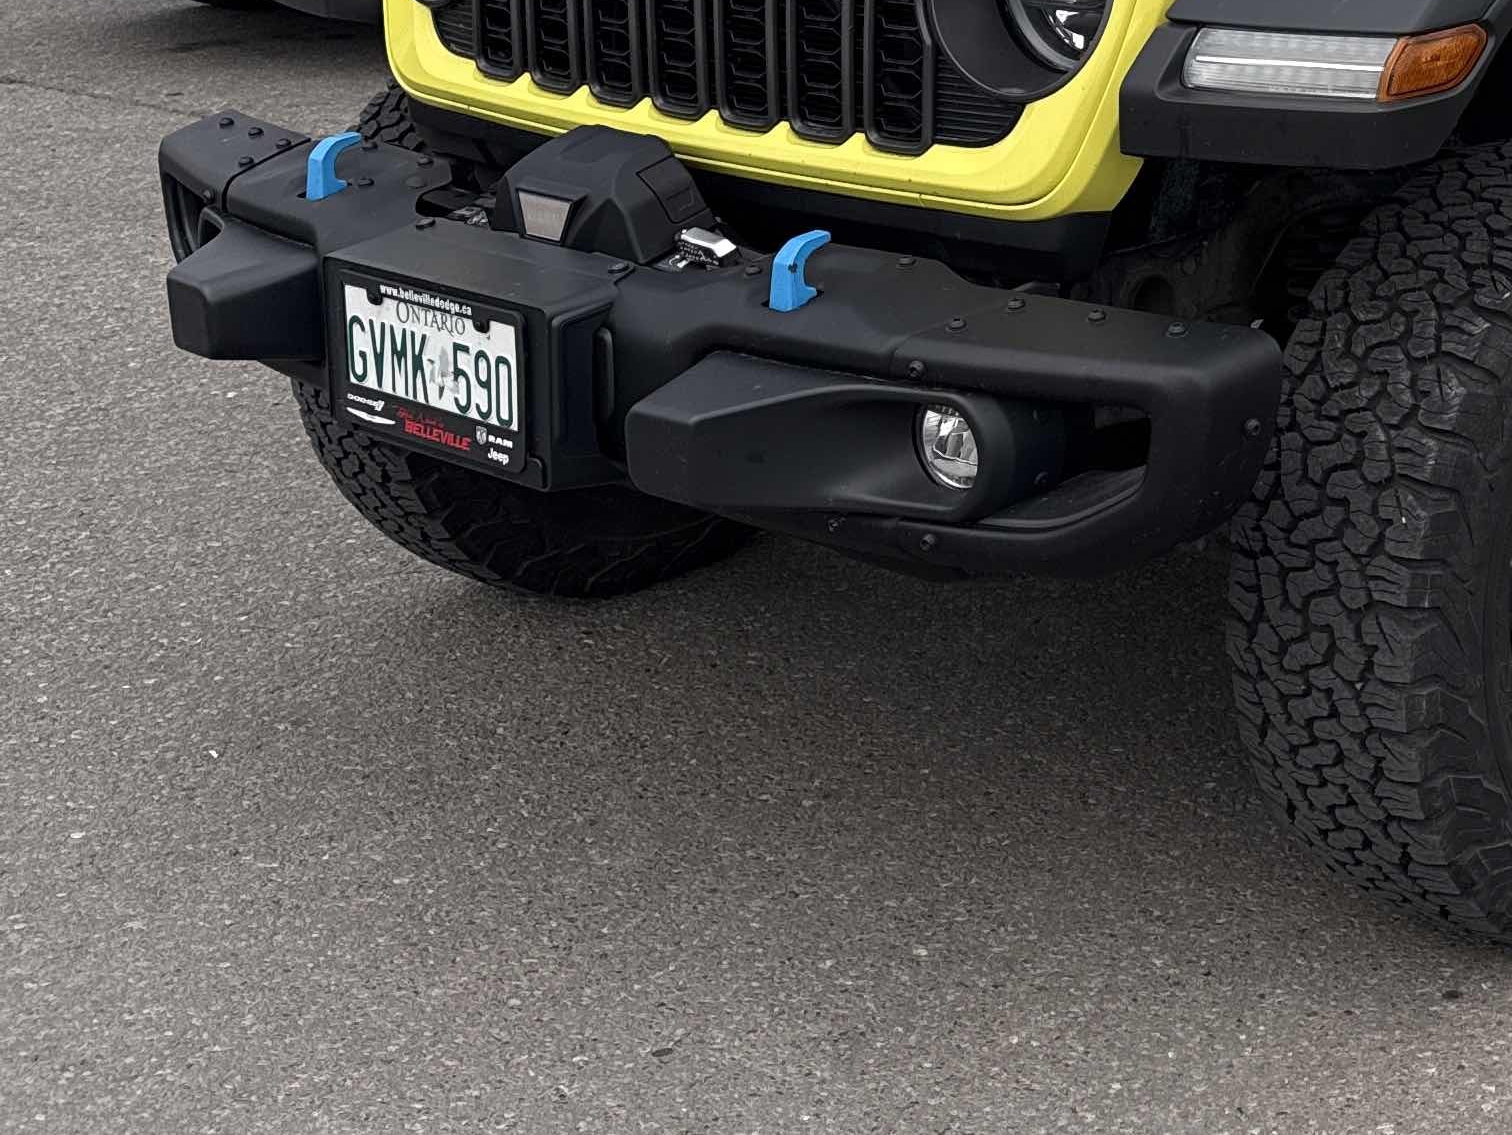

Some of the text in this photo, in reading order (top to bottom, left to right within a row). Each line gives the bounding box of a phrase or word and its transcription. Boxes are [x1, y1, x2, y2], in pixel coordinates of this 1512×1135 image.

[380, 284, 472, 316] www.bellevilledodge.ca
[396, 301, 465, 337] ONTARIO
[348, 314, 514, 429] GVMK 590
[404, 420, 473, 451] BELLEVILLE
[488, 434, 513, 448] RAM
[488, 447, 510, 465] Jeep
